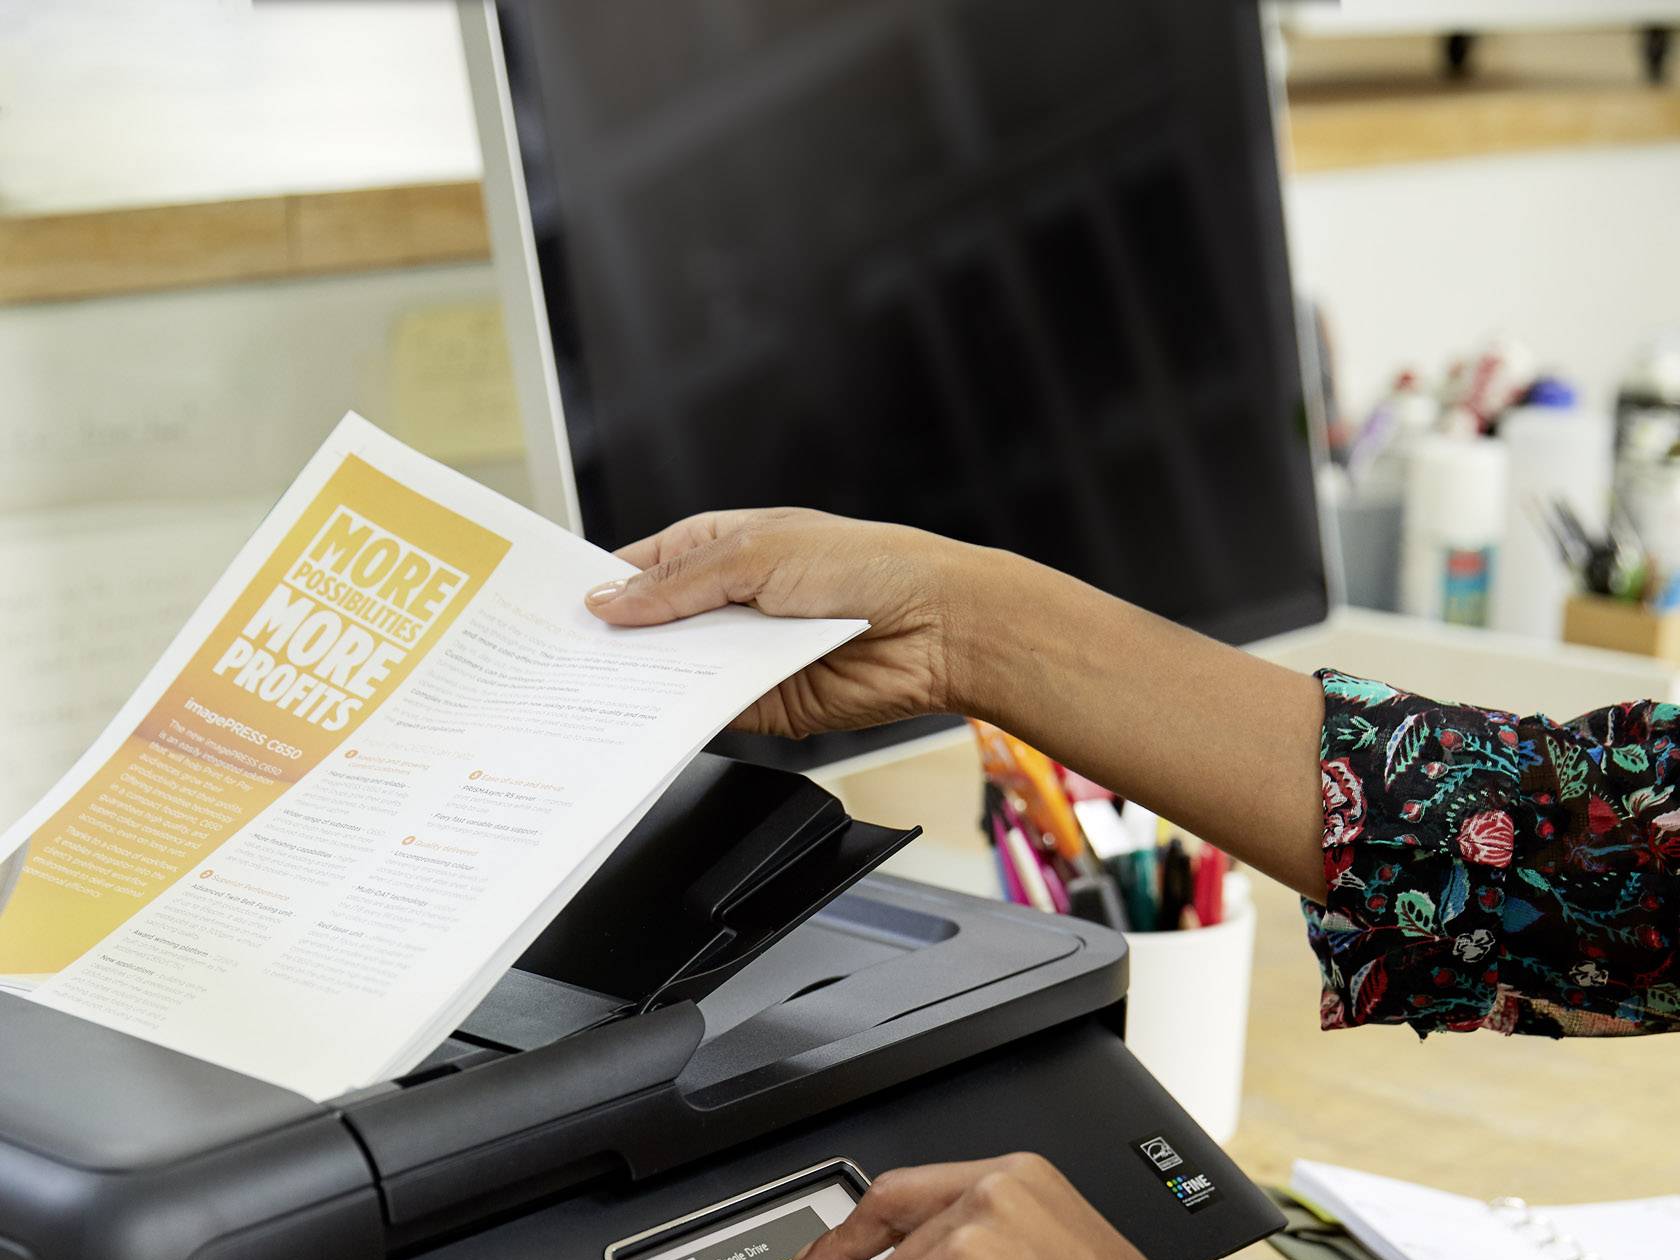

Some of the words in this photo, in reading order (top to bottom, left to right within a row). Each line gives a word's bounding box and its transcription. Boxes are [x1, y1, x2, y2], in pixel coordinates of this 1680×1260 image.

[292, 561, 422, 643] POSSIBILITIES
[309, 512, 461, 622] MORE
[242, 583, 408, 699] MORE
[212, 637, 364, 732] PROFITS
[184, 698, 267, 744] imagePRESS
[266, 739, 303, 760] C650
[1182, 1174, 1211, 1195] FINE
[745, 1241, 769, 1260] Drive
